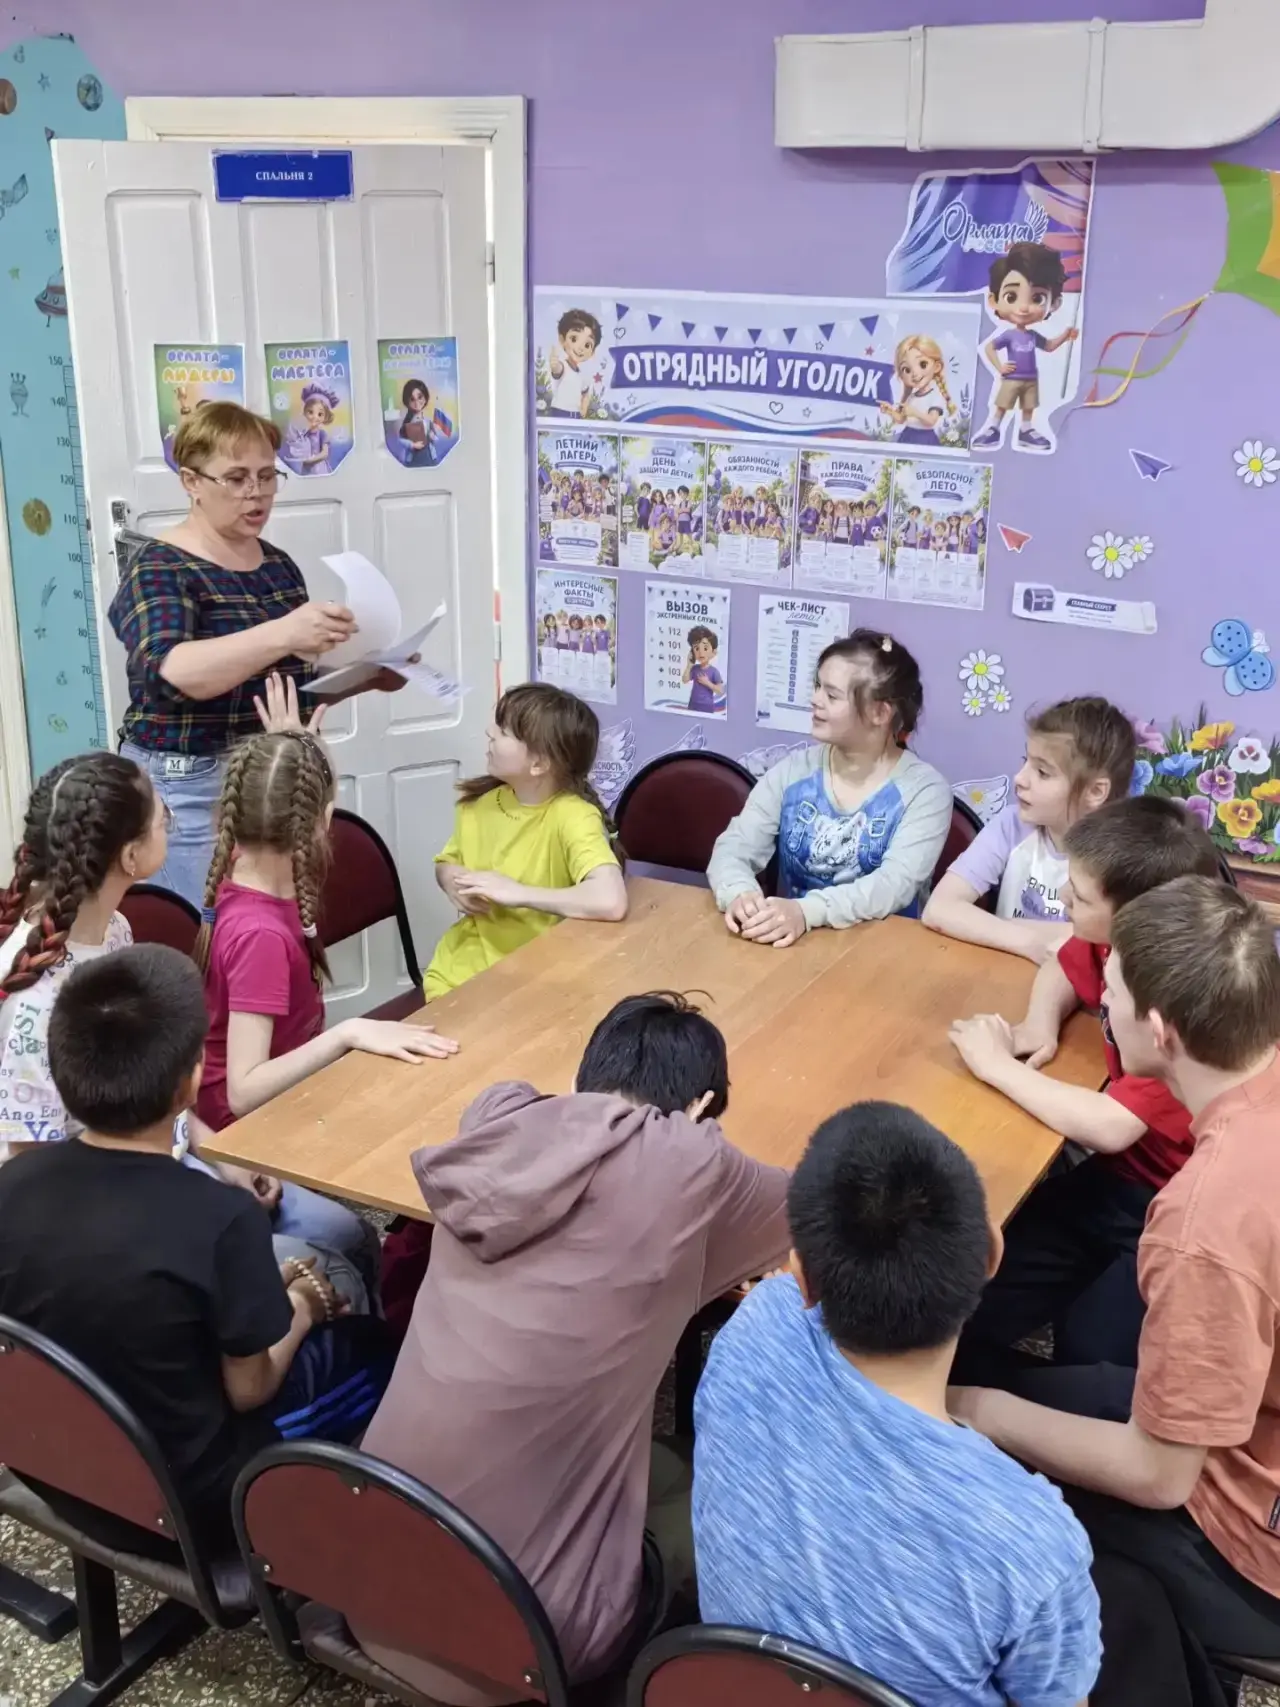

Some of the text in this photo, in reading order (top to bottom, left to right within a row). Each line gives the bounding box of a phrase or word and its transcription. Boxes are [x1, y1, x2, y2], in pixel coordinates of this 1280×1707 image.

[255, 171, 314, 181] СПАЛЬНЯ 2
[48, 355, 63, 366] 150
[162, 366, 235, 384] ЛИДЕРЫ
[271, 362, 344, 380] МАСТЕРА
[622, 348, 884, 400] ОТРЯДНЫЙ УГОЛОК
[52, 397, 67, 407] 140
[57, 436, 71, 448] 130
[555, 438, 599, 452] ЛЕТНИЙ
[560, 450, 597, 463] ЛАГЕРЬ
[652, 457, 676, 467] ДЕНЬ
[727, 455, 780, 468] ОБЯЗАННОСТИ
[639, 466, 669, 474] ЗАЩИТЫ
[670, 469, 694, 480] ДЕТЕЙ
[723, 464, 755, 473] КАЖДОГО
[831, 461, 863, 473] ПРАВА
[60, 474, 74, 485] 120
[916, 470, 975, 486] БЕЗОПАСНОЕ
[930, 480, 957, 492] ЛЕТО
[64, 513, 77, 525] 110
[68, 552, 82, 562] 100
[554, 580, 604, 594] ИНТЕРЕСНЫЕ
[564, 588, 593, 599] ФАКТЫ
[666, 600, 708, 615] ВЫЗОВ
[778, 601, 826, 615] ЧЕК-ЛИСТ
[656, 612, 718, 624] ЭКСТРЕННЫХ СЛУЖБ
[668, 626, 681, 636] 112
[668, 640, 681, 650] 101
[668, 654, 681, 663] 102
[668, 667, 681, 676] 103
[668, 681, 681, 689] 104
